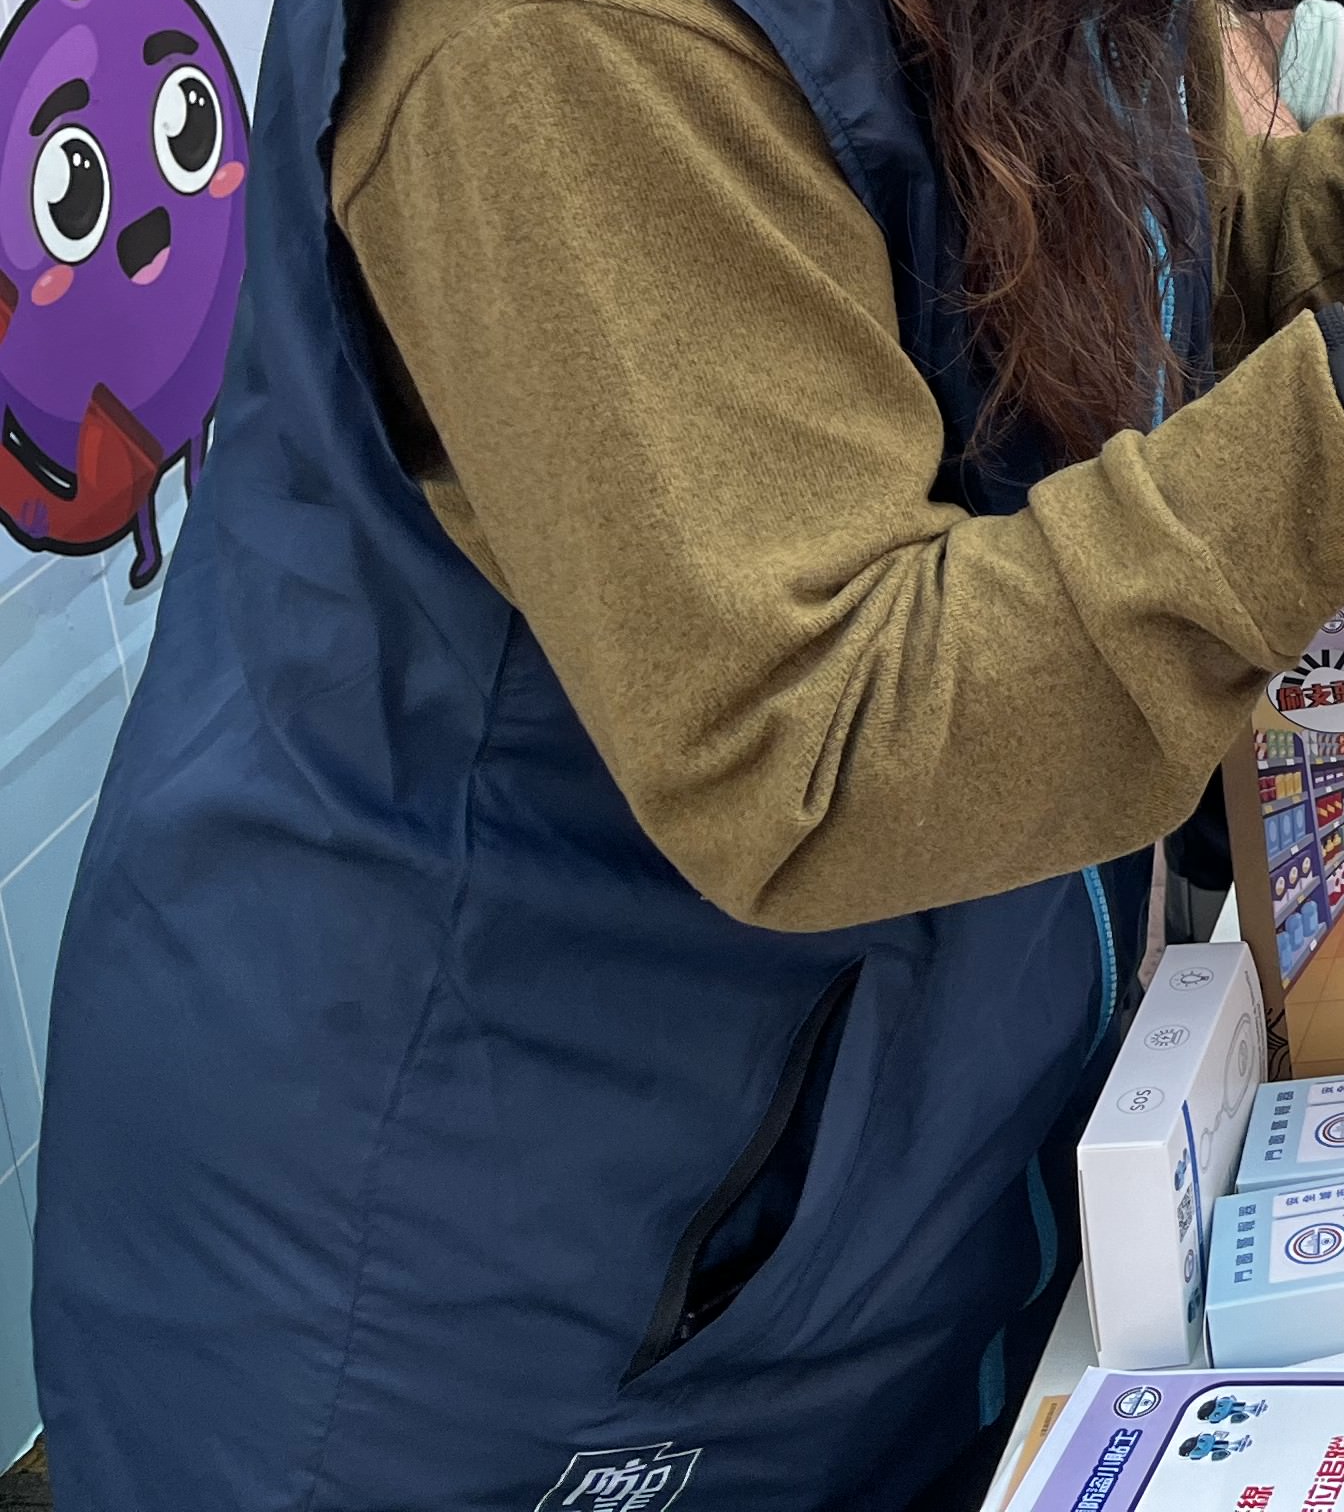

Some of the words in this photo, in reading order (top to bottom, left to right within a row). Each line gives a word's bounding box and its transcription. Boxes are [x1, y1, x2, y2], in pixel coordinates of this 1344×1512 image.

[1129, 1088, 1152, 1112] SOS
[1073, 1430, 1139, 1512] 防盜小貼士
